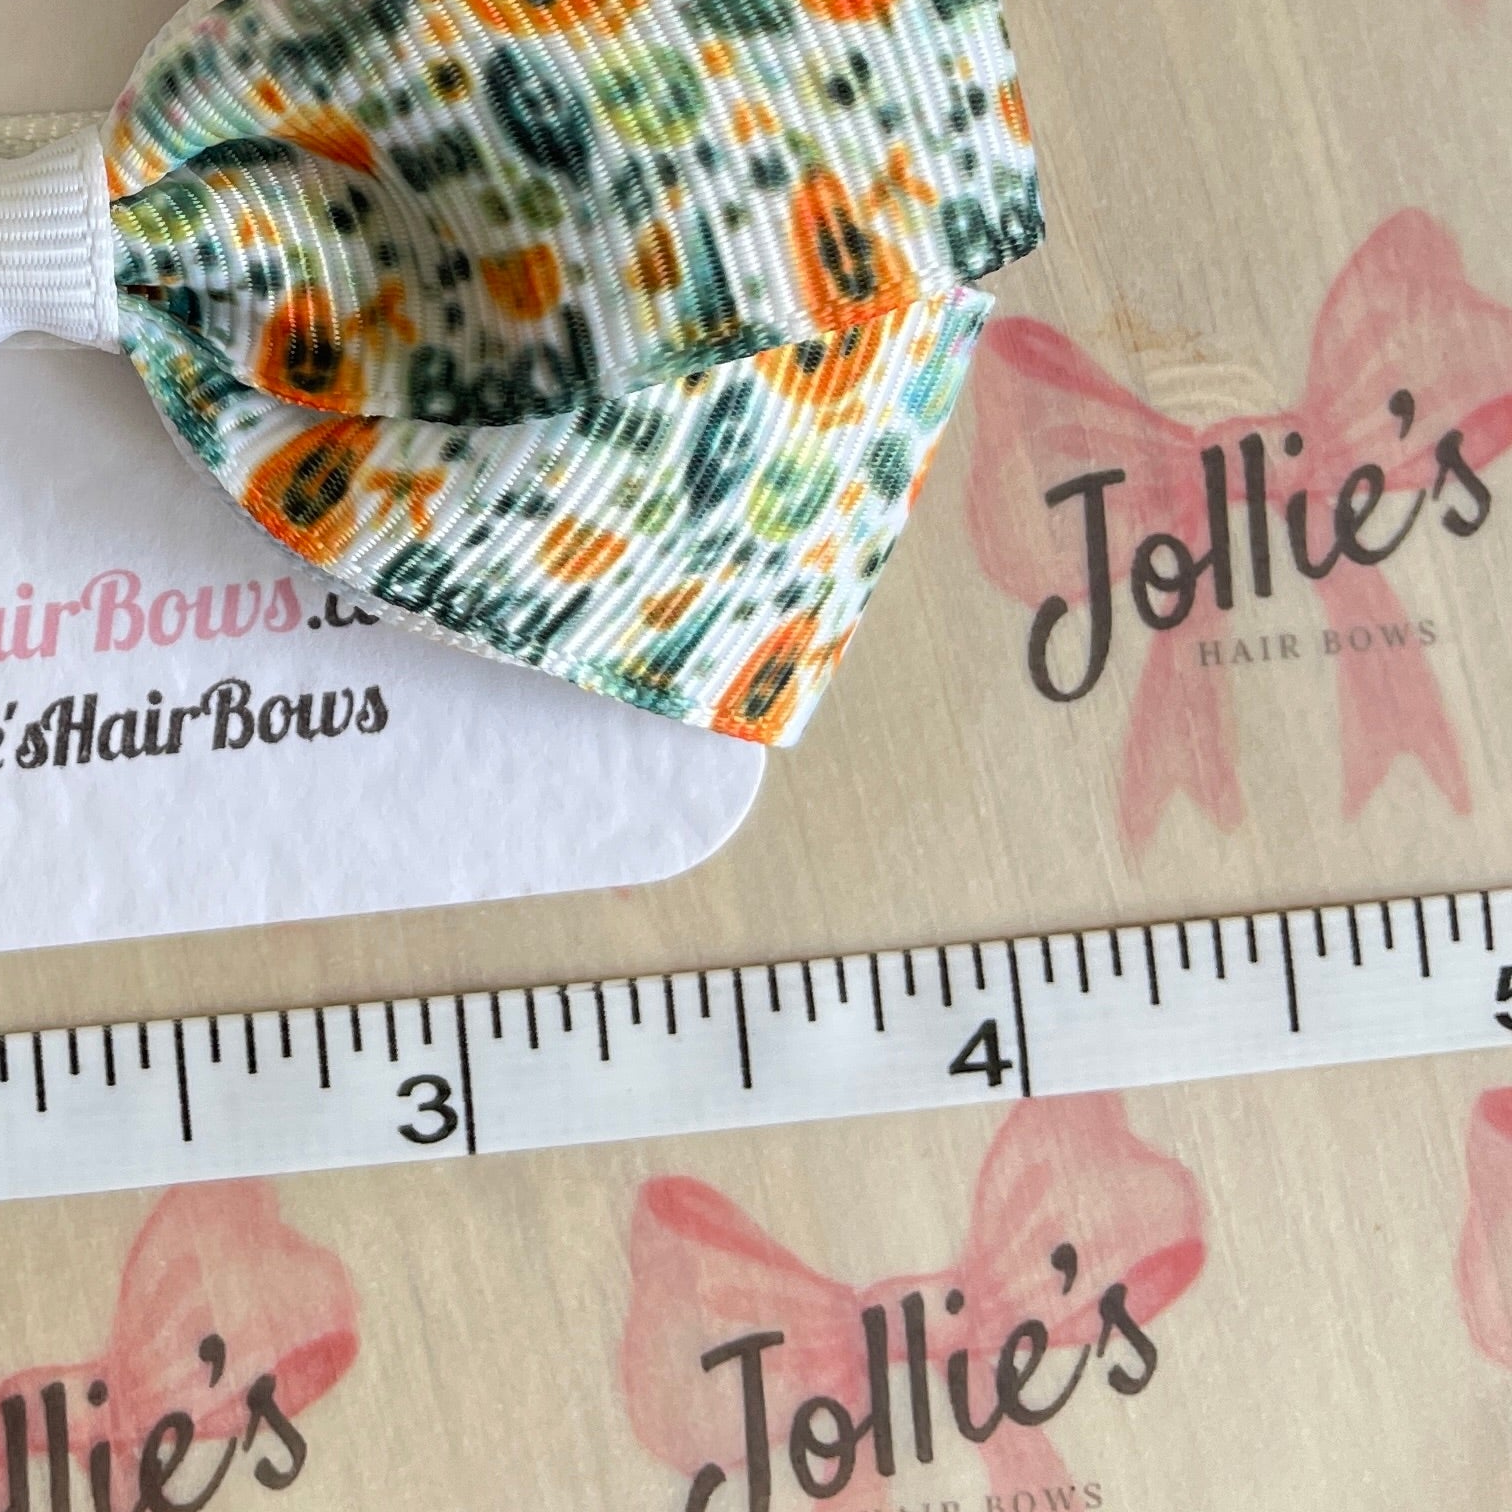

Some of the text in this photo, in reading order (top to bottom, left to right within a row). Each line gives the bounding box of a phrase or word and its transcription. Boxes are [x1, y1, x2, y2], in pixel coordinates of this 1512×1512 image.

[1028, 388, 1492, 702] Jollie's
[1198, 619, 1439, 668] HAIR BOWS
[949, 1018, 1014, 1086] 4
[396, 1073, 459, 1144] 3
